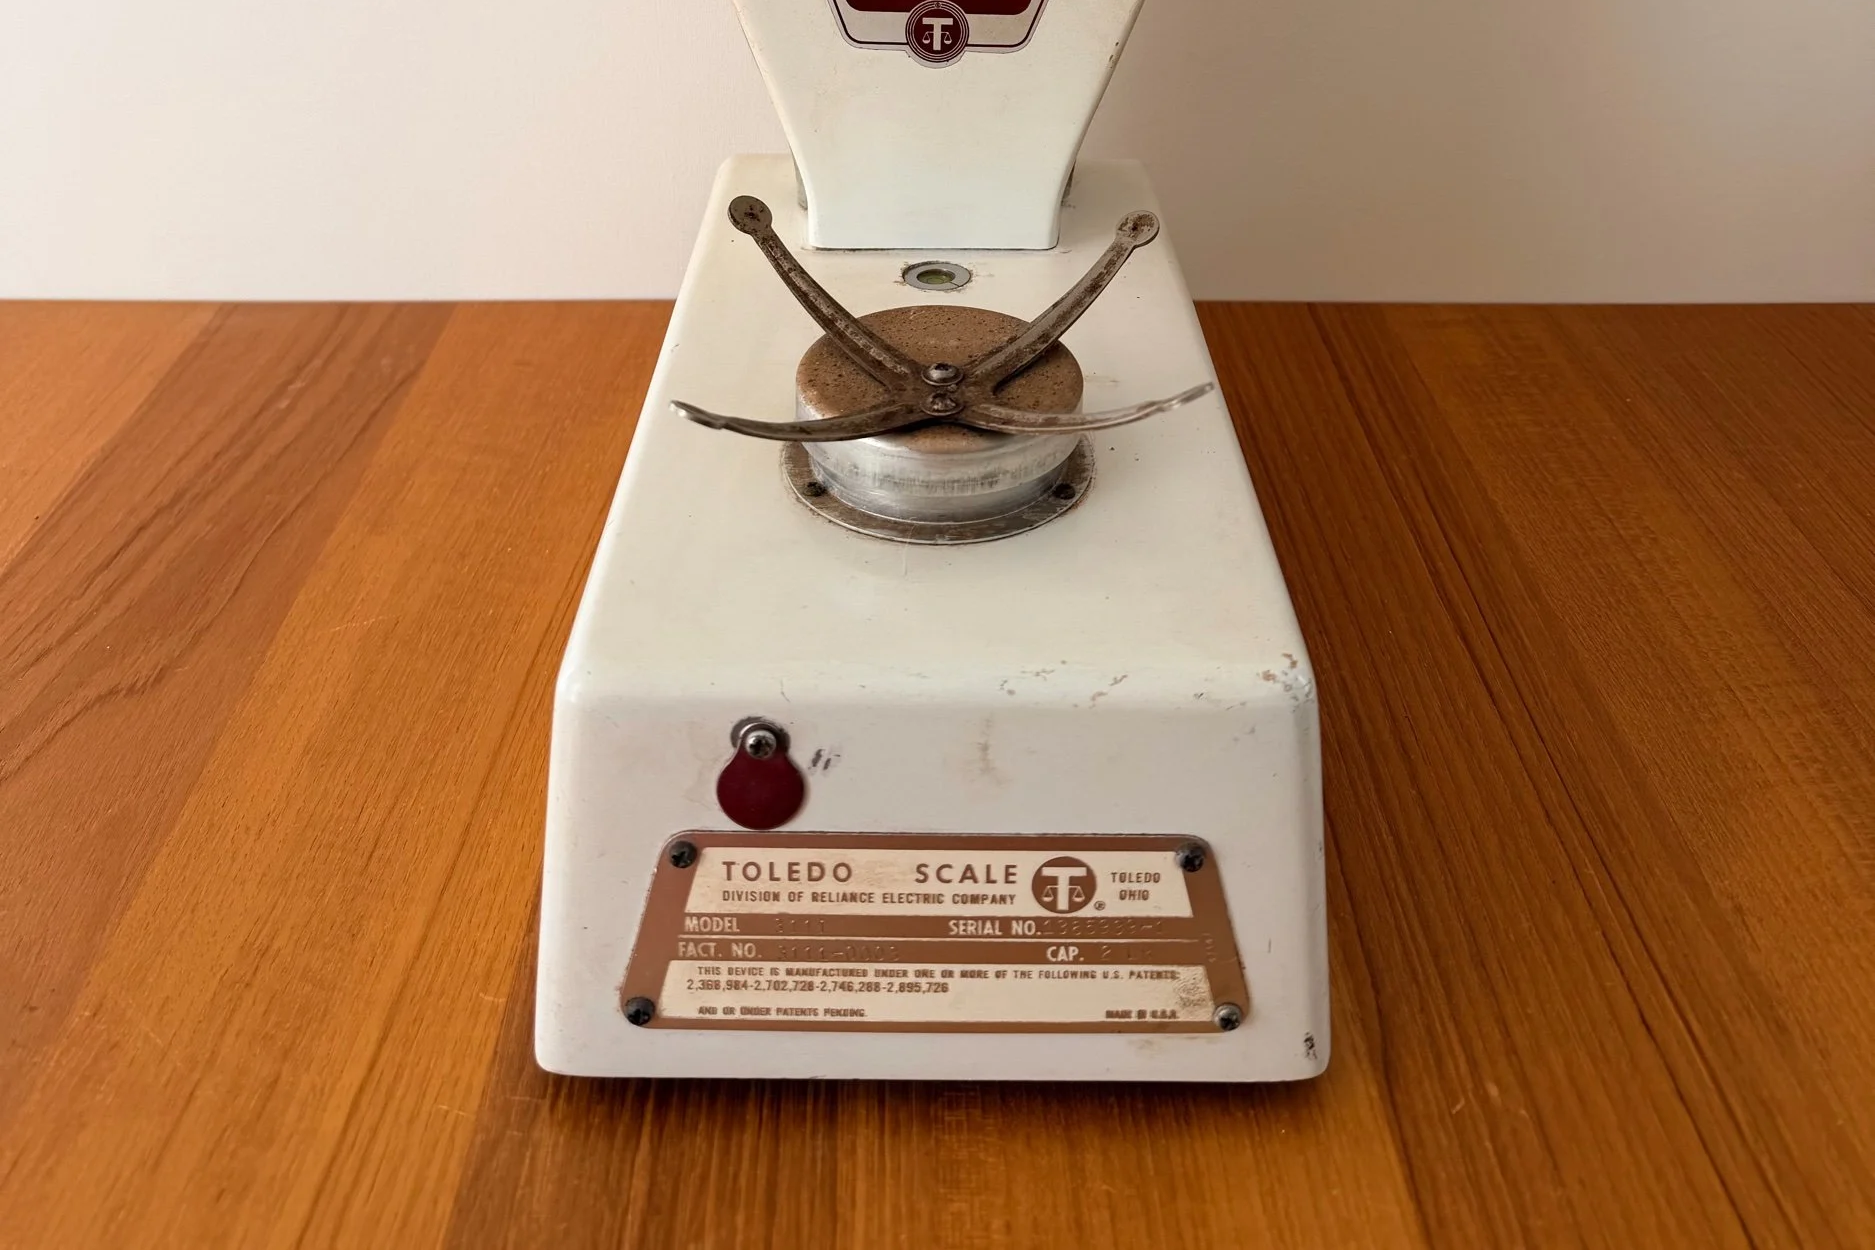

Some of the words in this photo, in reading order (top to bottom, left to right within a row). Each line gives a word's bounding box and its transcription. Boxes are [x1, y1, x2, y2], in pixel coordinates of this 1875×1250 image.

[722, 861, 853, 883] TOLEDO
[915, 863, 1019, 884] SCALE
[1111, 872, 1161, 884] TOLEDO
[723, 890, 780, 902] DIVISION
[788, 891, 804, 903] OF
[812, 891, 874, 904] RELIANCE
[882, 892, 944, 905] ELECTRIC
[952, 893, 1016, 906] COMPANY
[1119, 889, 1150, 901] OHIO
[684, 917, 740, 933] MODEL
[948, 919, 1002, 936] SERIAL
[1011, 920, 1042, 936] NO.
[678, 941, 722, 958] FACT.
[731, 942, 762, 958] NO.
[1046, 946, 1084, 962] CAP.
[698, 966, 721, 976] THIS
[728, 967, 764, 977] DEVICE
[770, 967, 780, 977] IS
[786, 967, 868, 978] MANUFACTURED
[875, 968, 908, 978] UNDER
[914, 969, 935, 979] ONE
[941, 969, 954, 979] OR
[960, 969, 989, 979] MORE
[995, 969, 1007, 979] OF
[1013, 969, 1033, 979] THE
[1039, 969, 1097, 980] FOLLOWING
[1103, 970, 1123, 980] U.S.
[698, 1006, 717, 1016] AND
[723, 1006, 735, 1016] OR
[740, 1006, 772, 1017] UNDER
[776, 1007, 819, 1018] PATENTS
